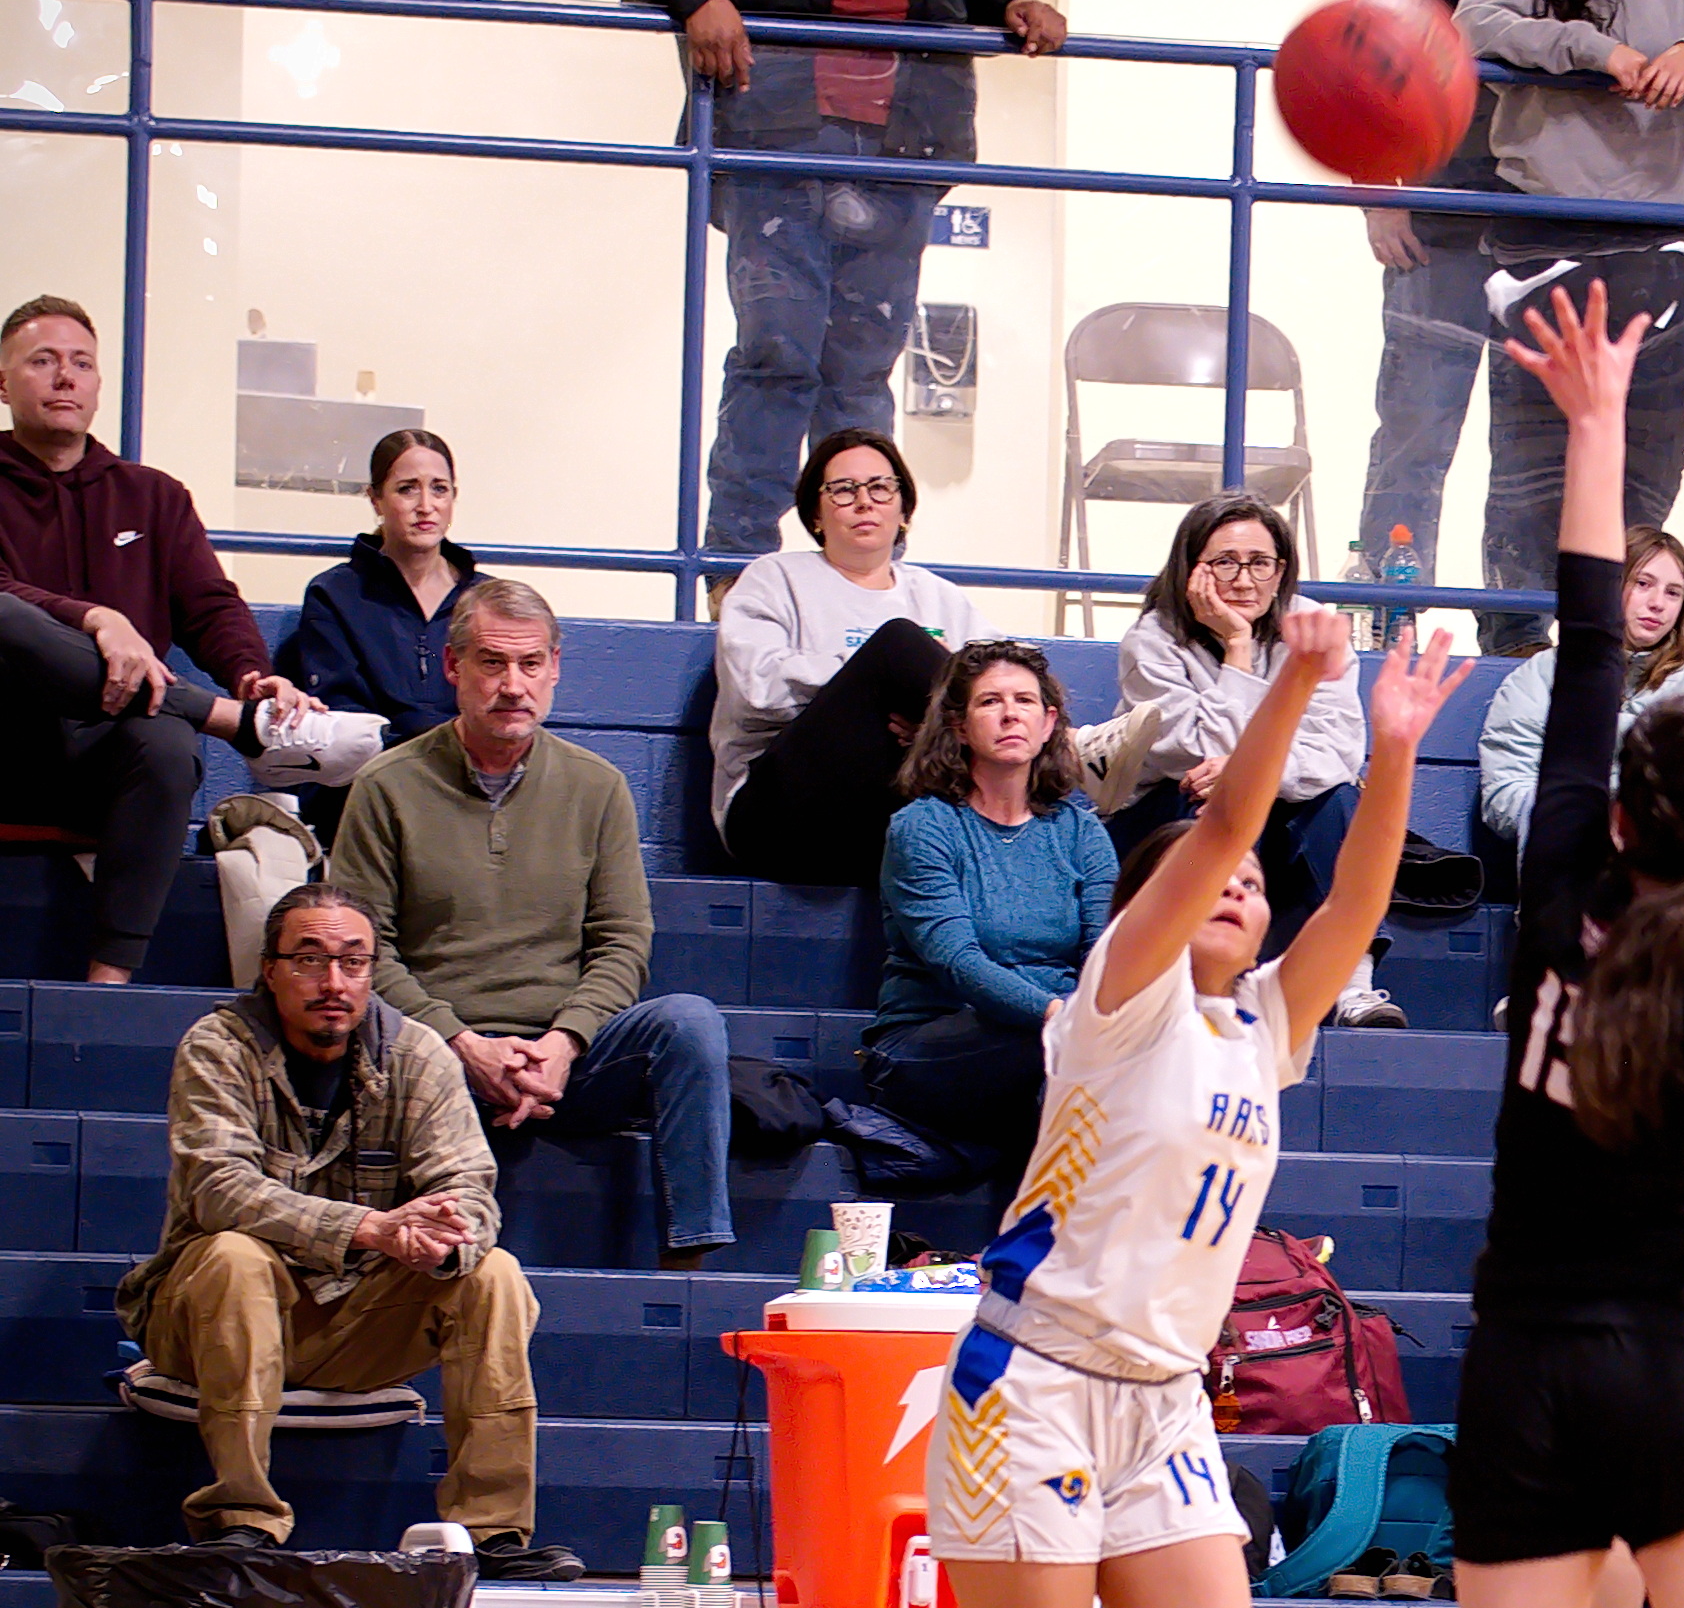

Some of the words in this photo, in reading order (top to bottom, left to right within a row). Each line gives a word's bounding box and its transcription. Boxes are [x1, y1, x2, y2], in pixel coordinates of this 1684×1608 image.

[1207, 1093, 1269, 1146] RAS
[1180, 1163, 1245, 1248] 14
[1164, 1451, 1219, 1506] 14
